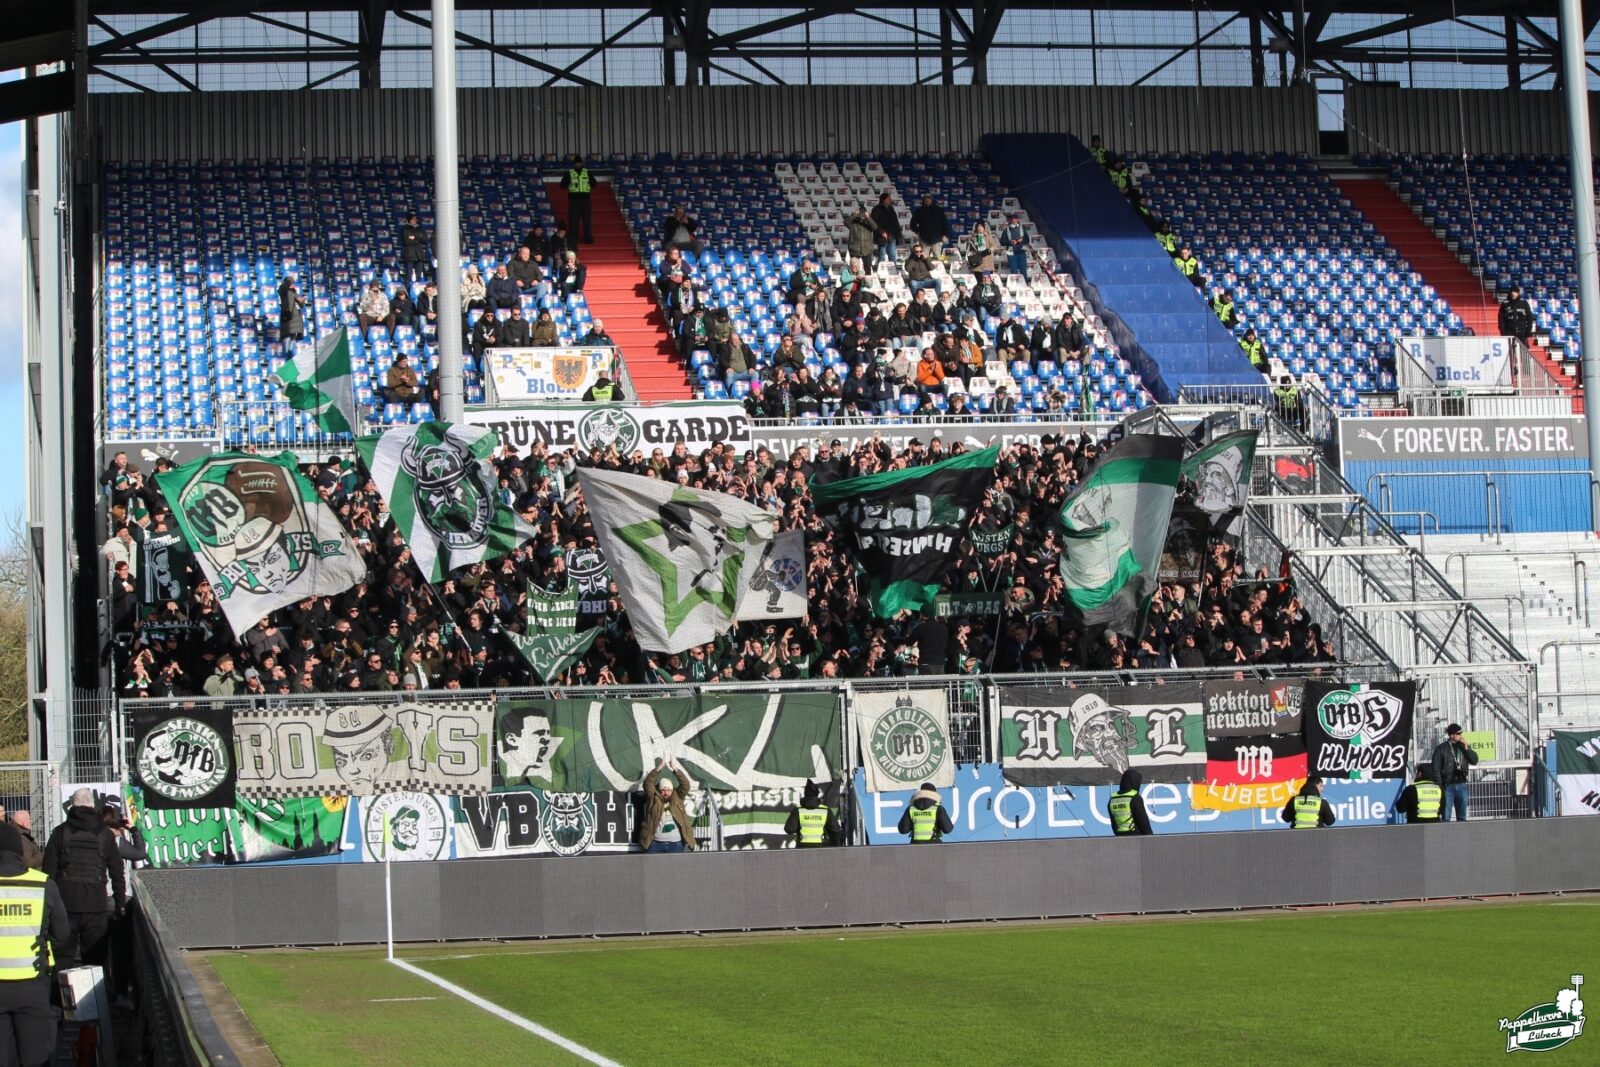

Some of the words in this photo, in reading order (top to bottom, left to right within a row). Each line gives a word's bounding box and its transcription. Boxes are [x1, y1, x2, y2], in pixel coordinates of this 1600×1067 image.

[1410, 343, 1422, 357] R
[1492, 343, 1502, 357] S
[1435, 366, 1480, 381] Block
[469, 416, 576, 447] RÜNE
[643, 414, 751, 443] GARDE
[1393, 427, 1490, 453] FOREVER.
[1495, 426, 1575, 452] FASTER.
[185, 488, 240, 537] VfB
[1081, 700, 1100, 715] 1919
[1209, 689, 1270, 713] sektion
[1331, 694, 1349, 702] 1919
[338, 710, 362, 728] BU
[877, 709, 936, 737] SUBKULTUR
[1206, 707, 1277, 730] neustadt
[1323, 702, 1361, 729] VfB
[168, 719, 220, 749] SEKTION
[892, 734, 925, 758] VfB
[1014, 710, 1062, 761] H
[1147, 708, 1186, 758] L
[173, 738, 214, 772] VfB
[1235, 745, 1273, 782] VfB
[1317, 743, 1346, 772] HL
[1345, 744, 1405, 773] HOOLS
[1208, 778, 1298, 805] LÜBECK
[372, 791, 439, 823] KÜSTENJUNGS
[370, 833, 379, 841] 19
[432, 830, 441, 838] 19
[0, 904, 32, 916] IMS
